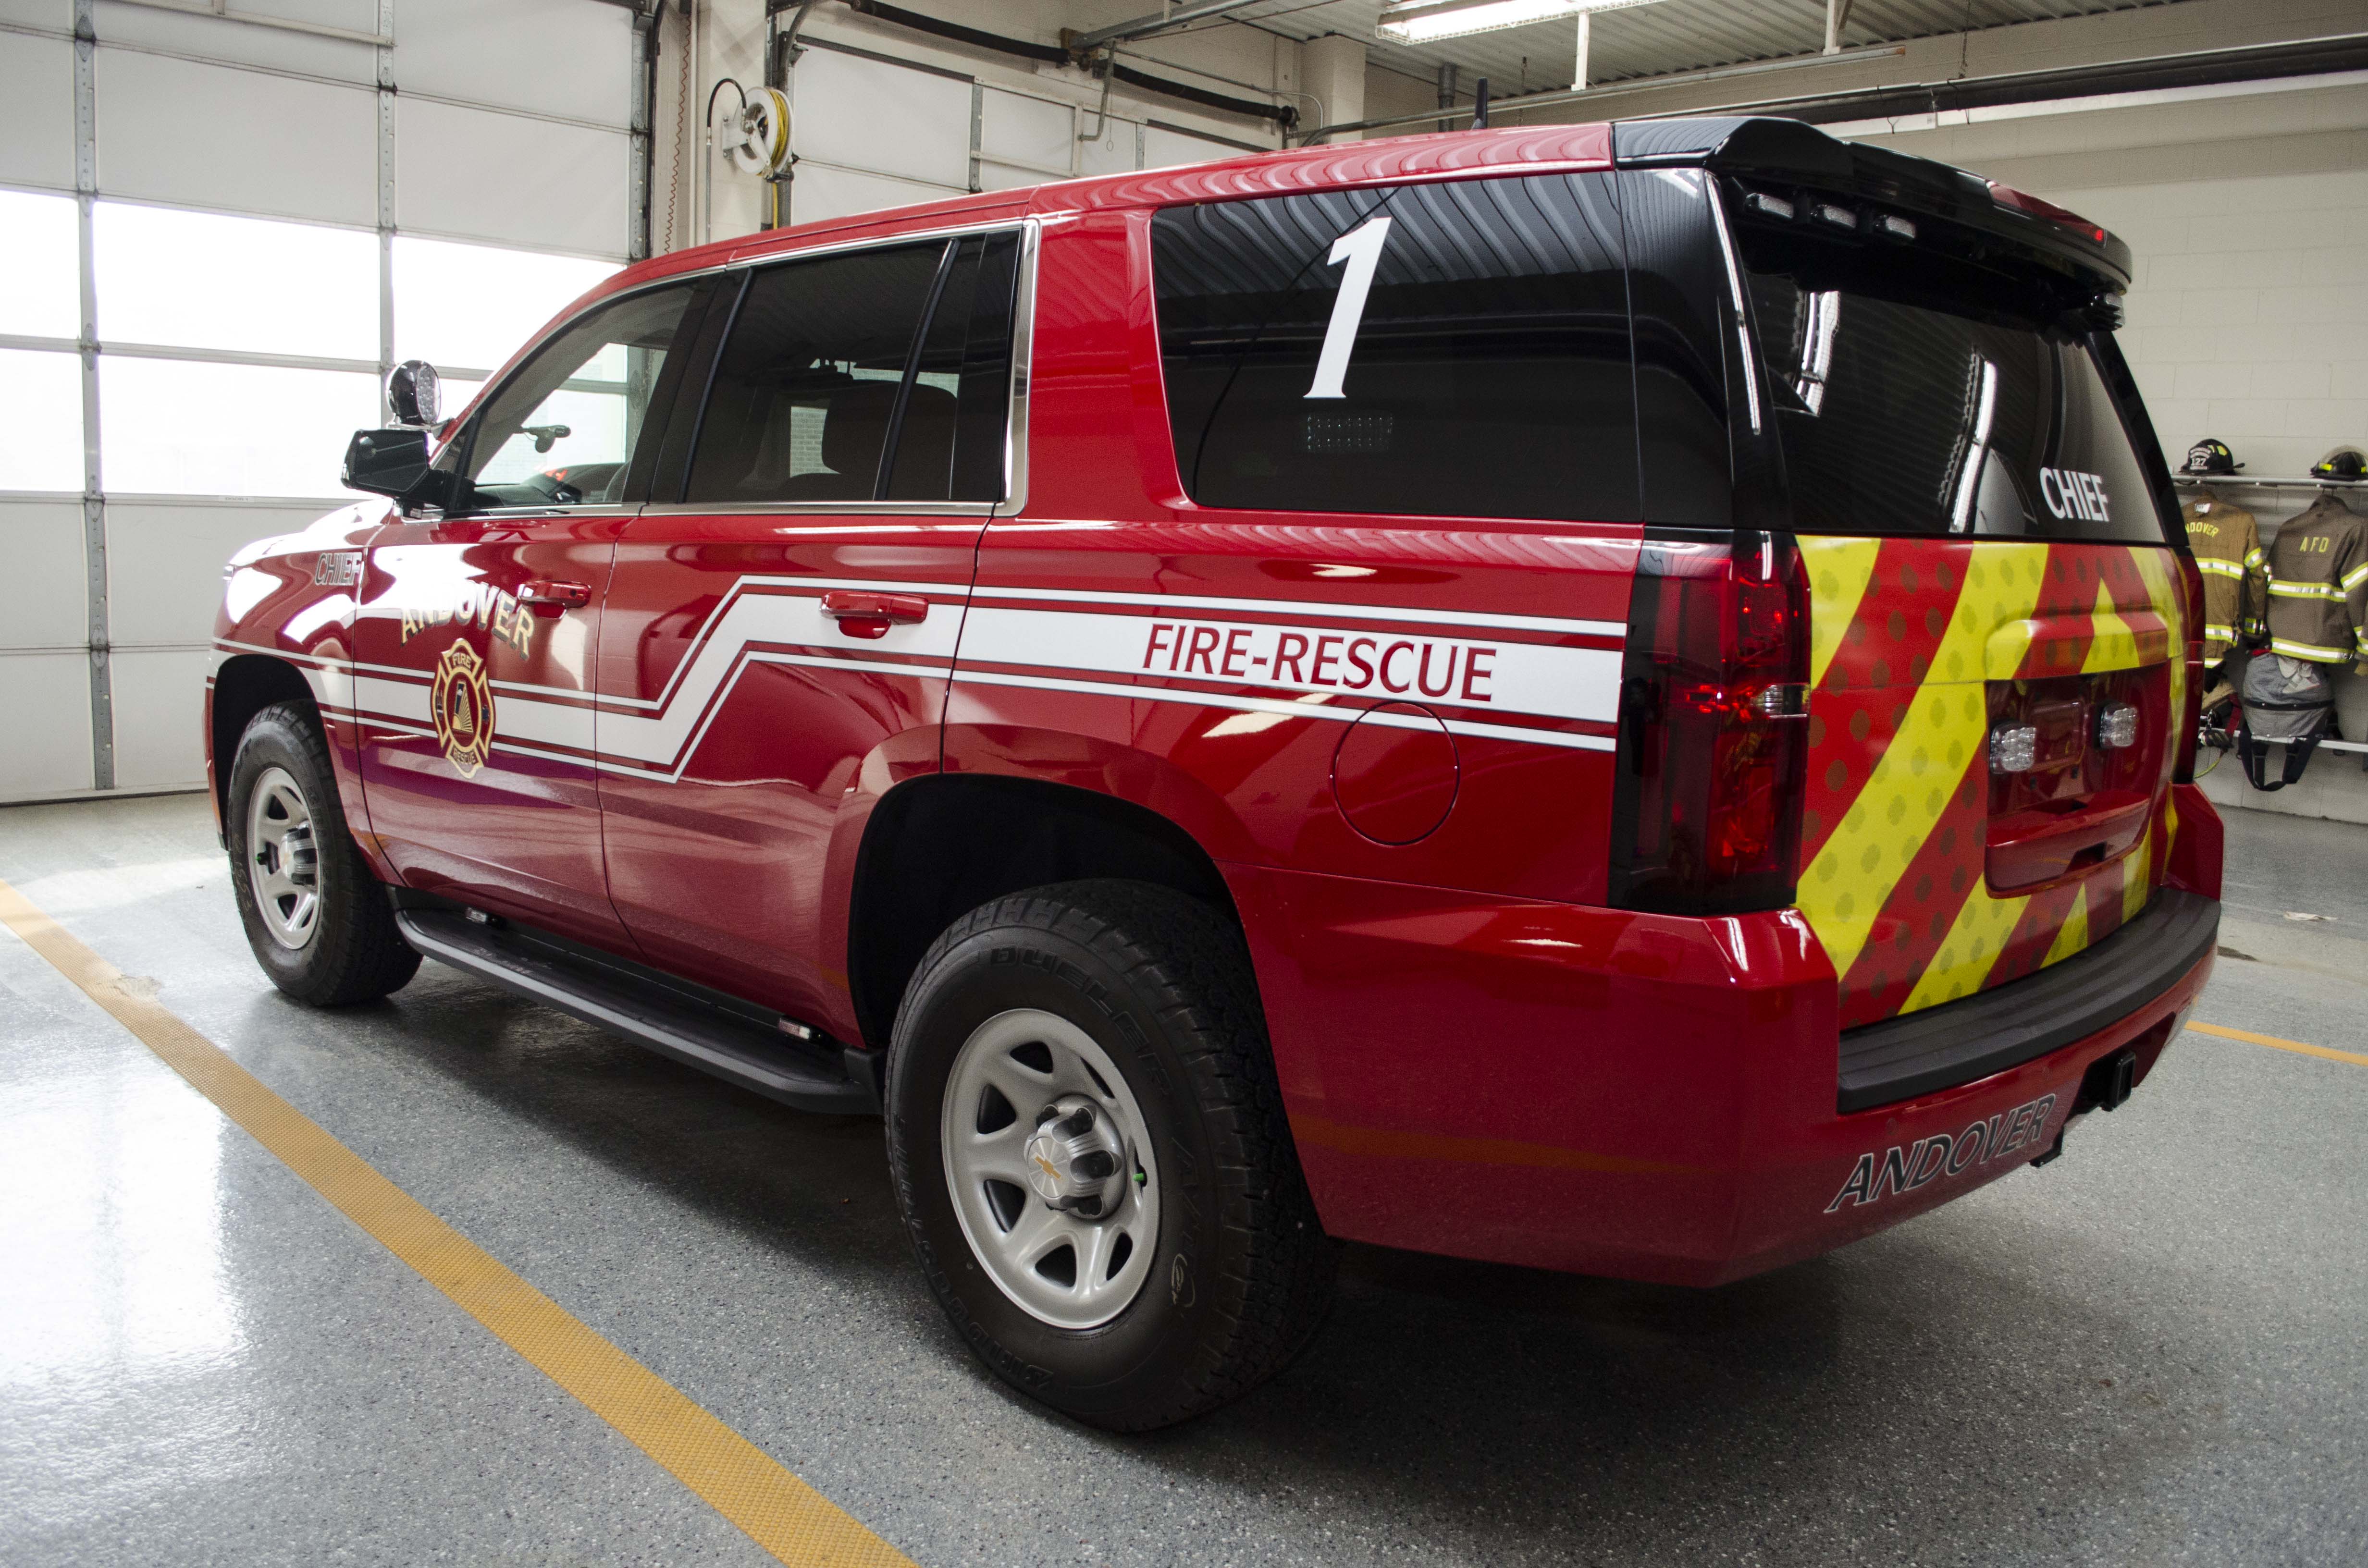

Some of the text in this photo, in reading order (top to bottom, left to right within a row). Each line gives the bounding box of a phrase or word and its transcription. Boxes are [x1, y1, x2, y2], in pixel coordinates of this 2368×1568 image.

[1303, 216, 1392, 399] 1
[2190, 458, 2207, 466] 127
[2039, 466, 2110, 523] CHIEF
[2184, 521, 2220, 538] NDOVER
[2299, 536, 2331, 553] AFD
[315, 552, 363, 586] CHIEF
[452, 652, 472, 670] FIRE
[1142, 623, 1498, 702] FIRE-RESCUE
[453, 747, 476, 764] RESCUE
[1823, 1092, 2056, 1213] ANDOVER
